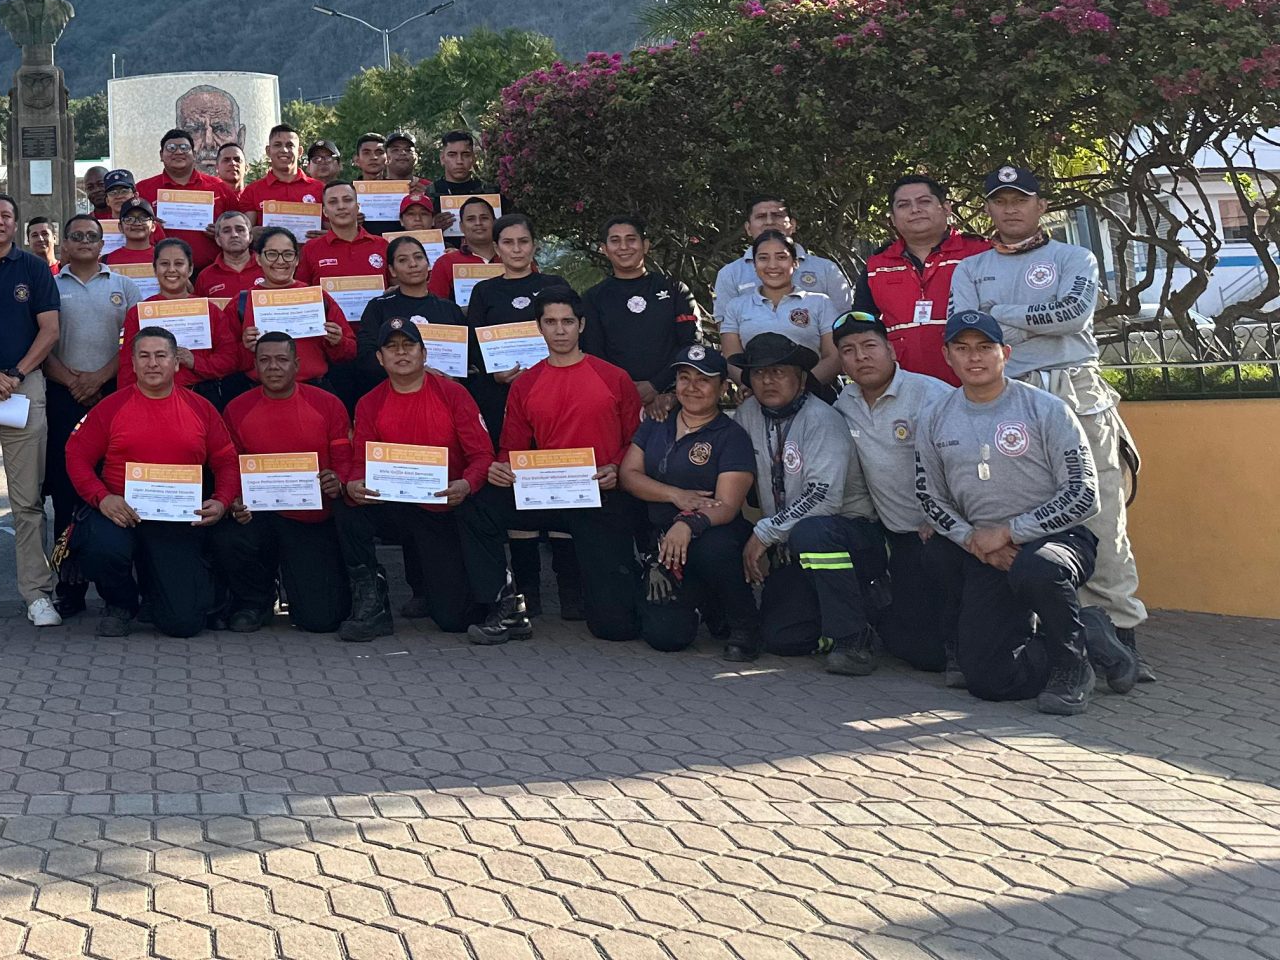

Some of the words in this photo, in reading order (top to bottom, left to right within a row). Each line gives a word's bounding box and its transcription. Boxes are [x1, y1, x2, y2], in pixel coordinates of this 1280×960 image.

[1025, 312, 1053, 326] PARA
[1034, 502, 1057, 521] NOS
[1040, 512, 1073, 532] PARA
